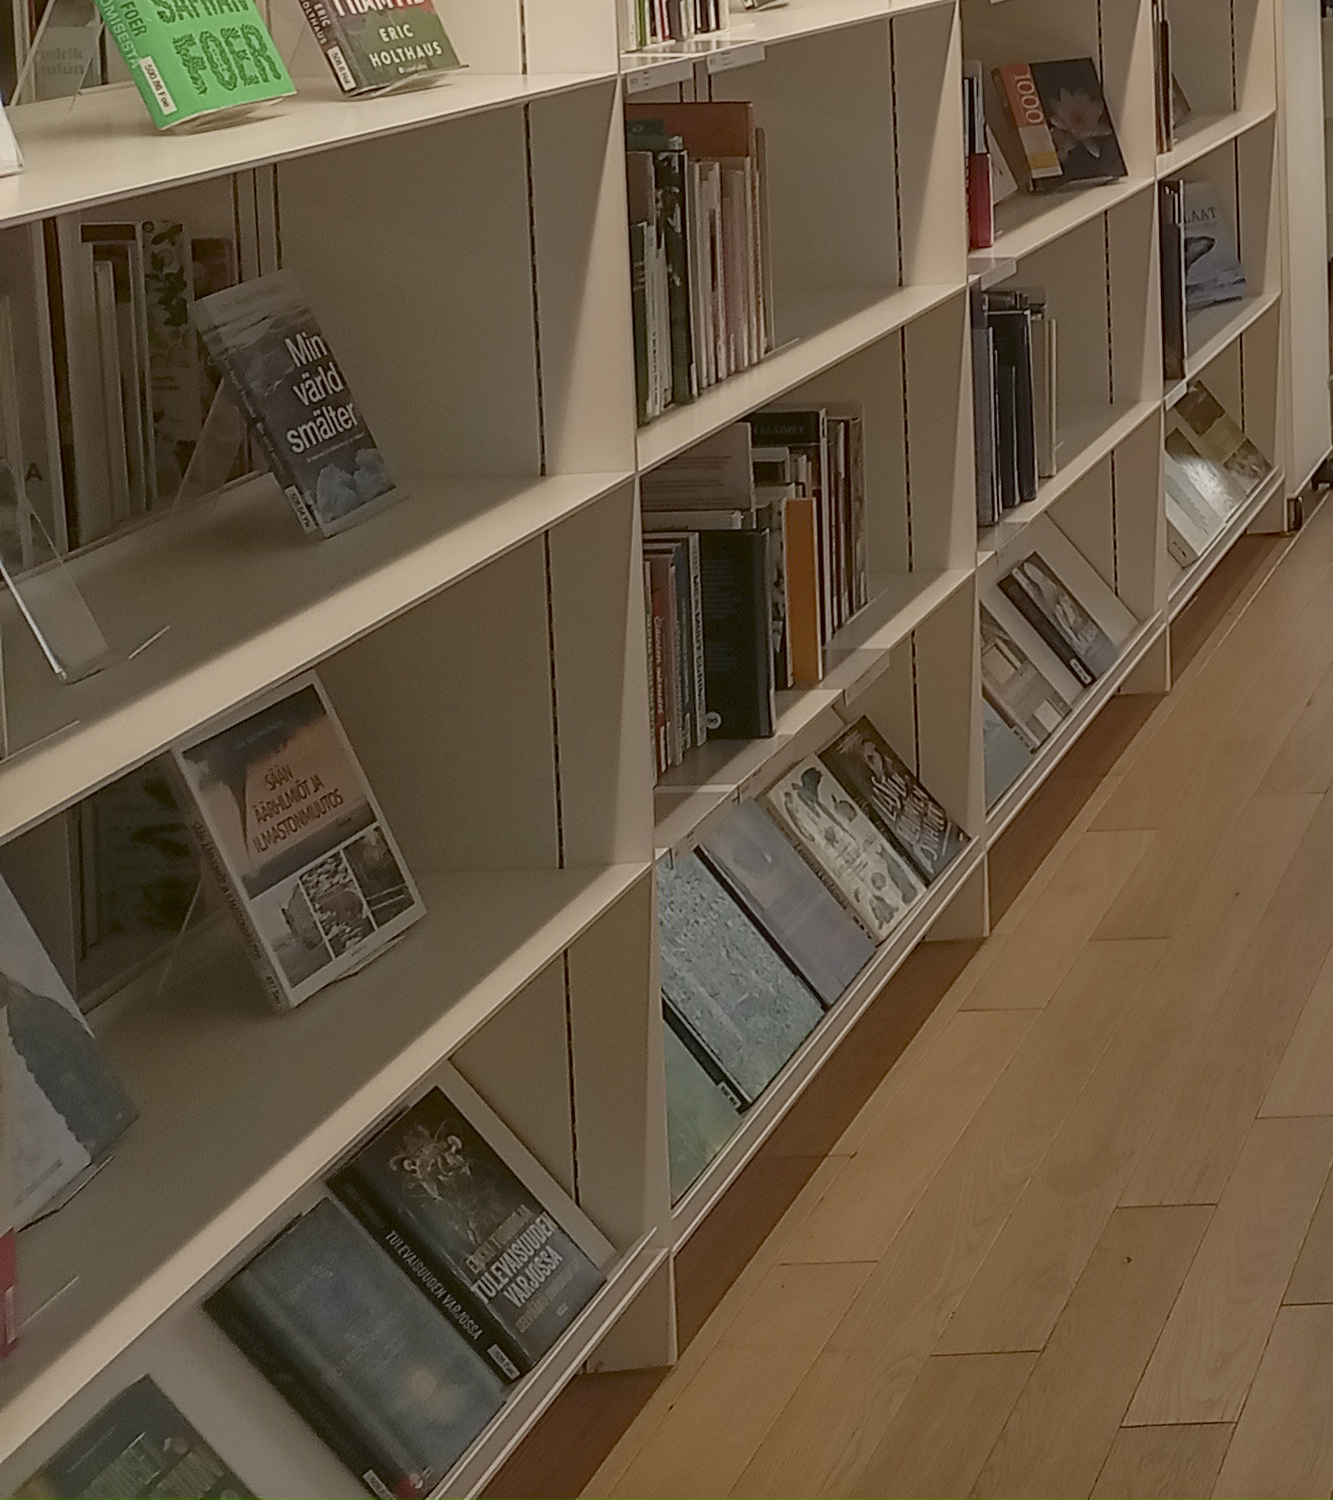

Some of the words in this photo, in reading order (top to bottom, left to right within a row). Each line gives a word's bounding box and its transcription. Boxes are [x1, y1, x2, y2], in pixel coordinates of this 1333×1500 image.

[120, 1, 148, 37] FOER
[313, 3, 331, 27] ERIC
[379, 24, 414, 42] ERIC
[172, 22, 283, 96] FOER
[369, 41, 442, 69] HOLTHAUS
[1013, 73, 1044, 124] 1000
[285, 332, 328, 367] Min
[293, 361, 344, 406] värld
[286, 403, 358, 453] smälter
[264, 763, 294, 791] SÄÄN
[310, 774, 325, 793] JA
[252, 788, 343, 853] ILMASTONMUUTOS
[471, 1210, 560, 1304] TULEVAISUUDEN
[503, 1245, 564, 1308] VARJOSSA
[385, 1229, 447, 1301] TULEVAISUUDEN
[443, 1291, 483, 1341] VARJOSSA
